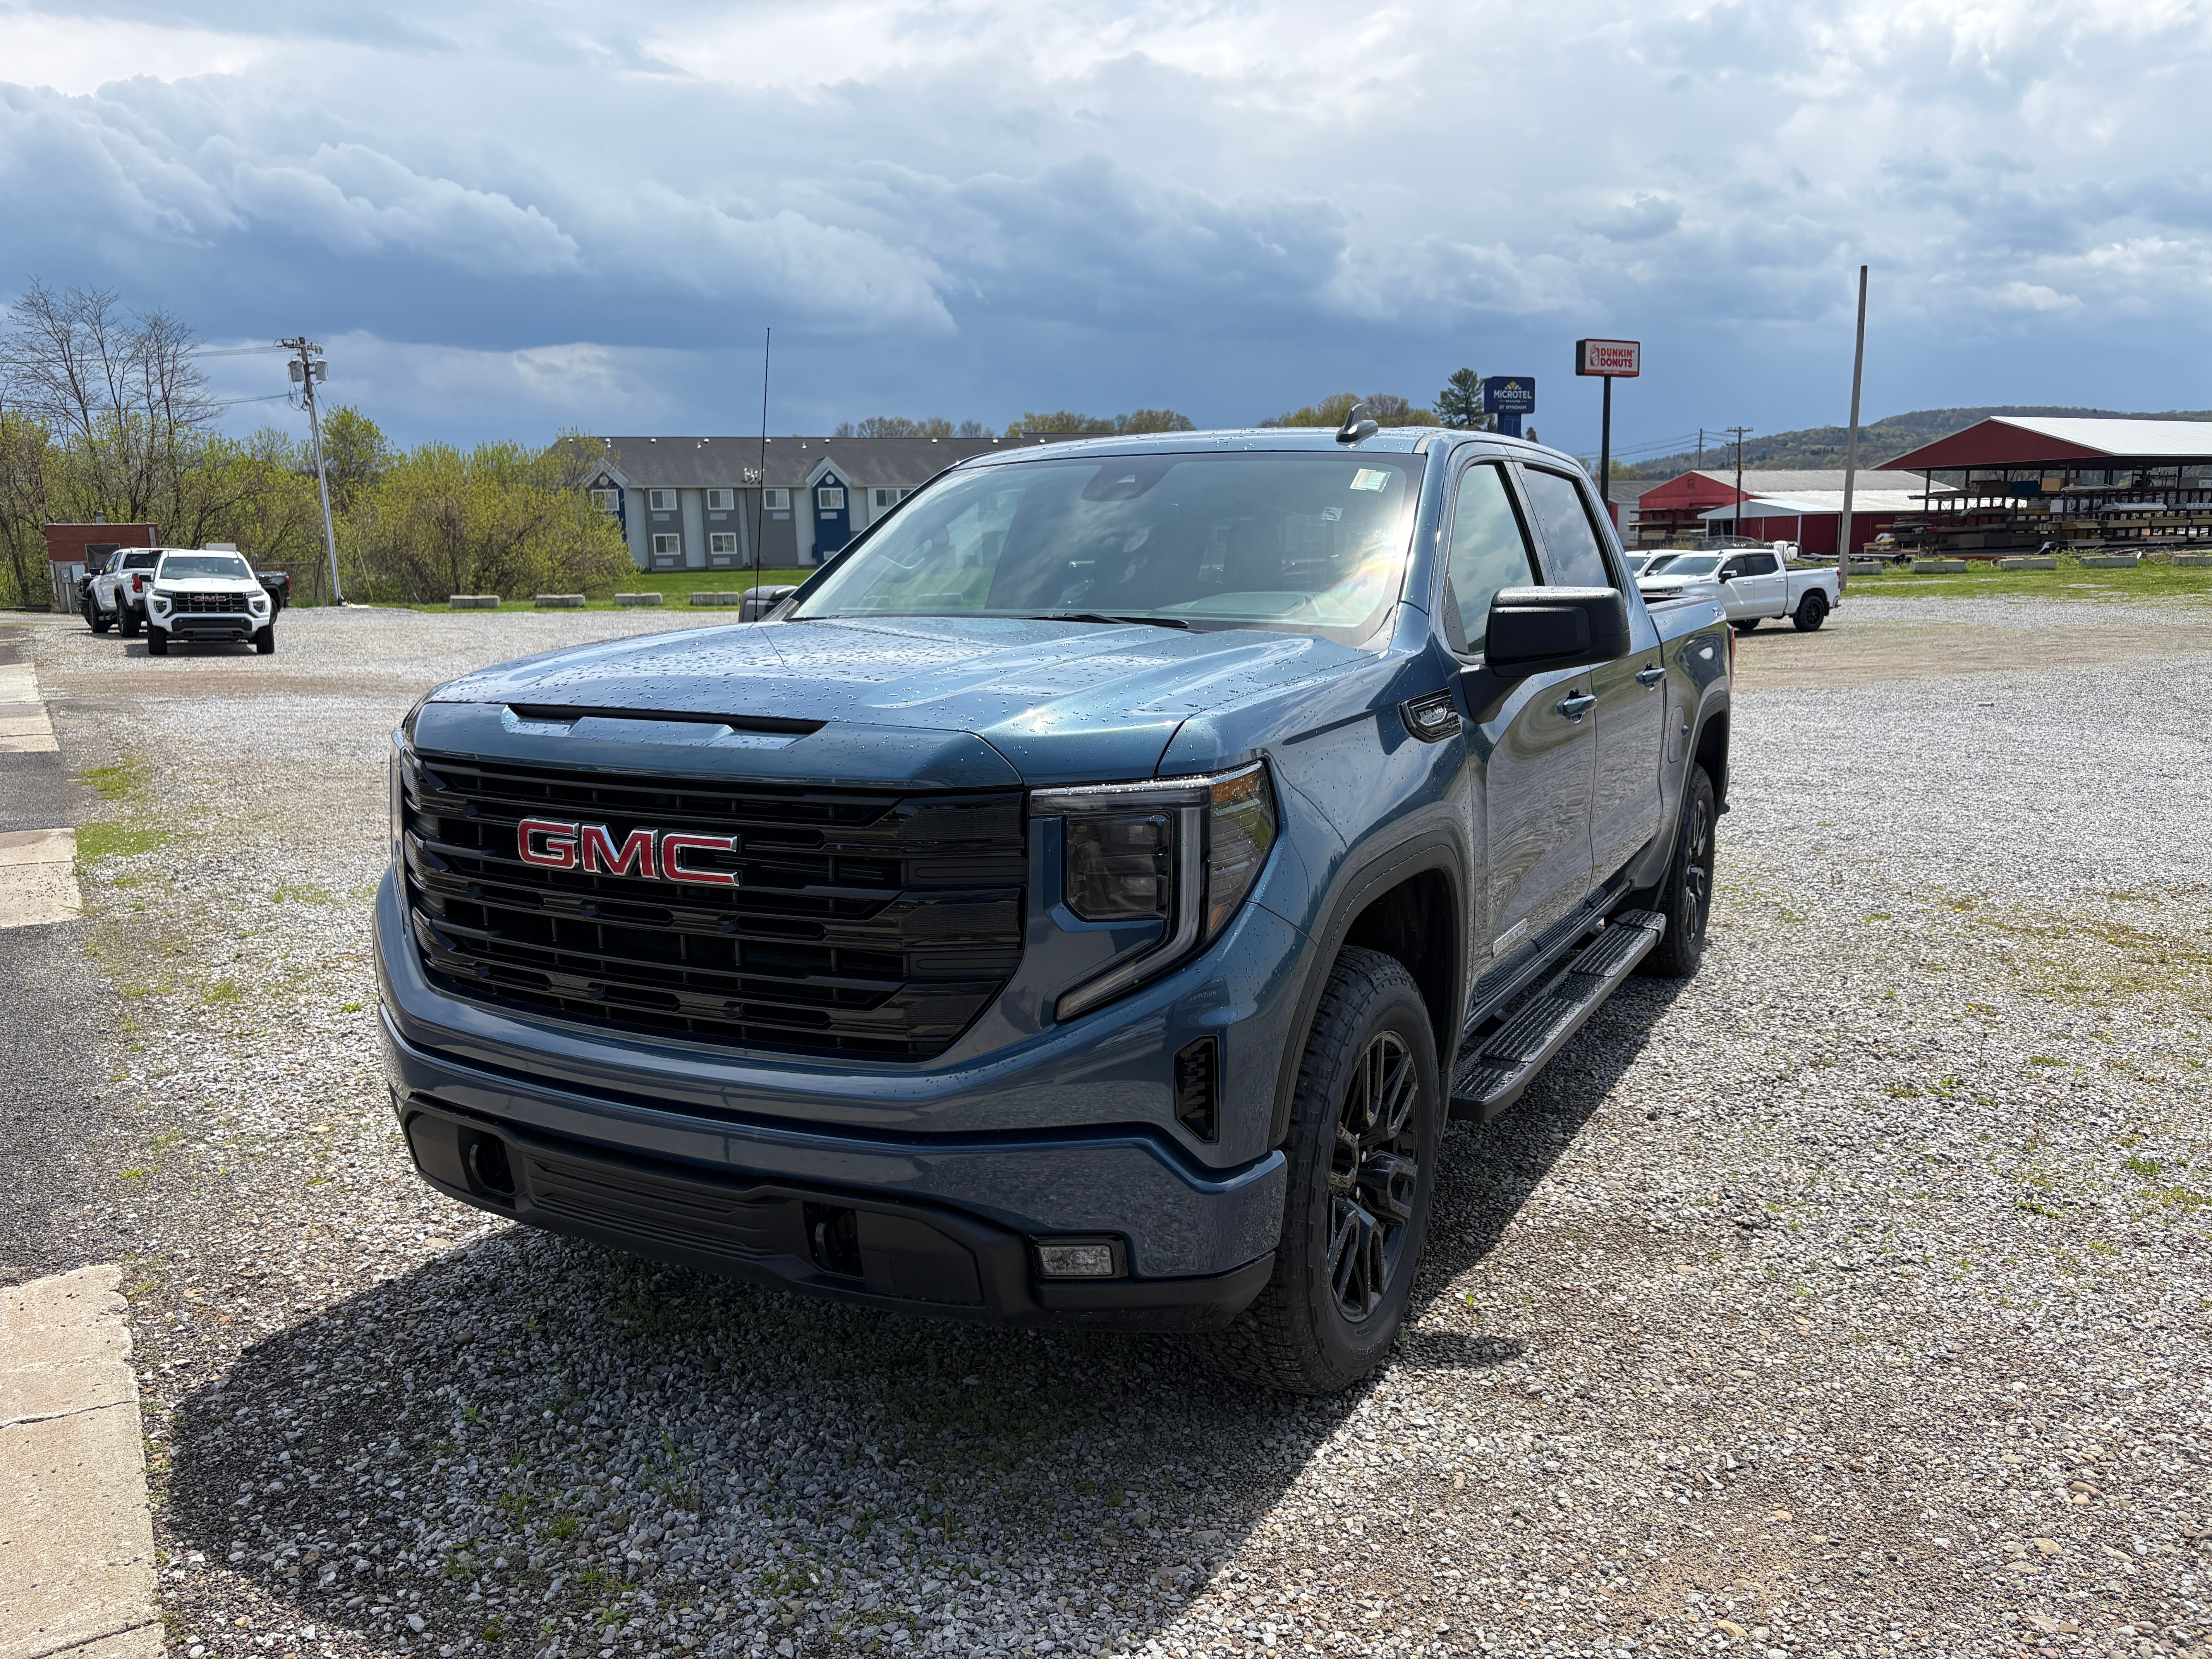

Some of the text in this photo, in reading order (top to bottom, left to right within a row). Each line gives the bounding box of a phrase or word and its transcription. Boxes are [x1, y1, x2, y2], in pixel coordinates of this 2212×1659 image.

[1601, 347, 1635, 358] DUNKIN'
[1601, 357, 1633, 368] DONUTS
[1494, 390, 1532, 399] MICROTEL
[517, 818, 740, 887] GMC
